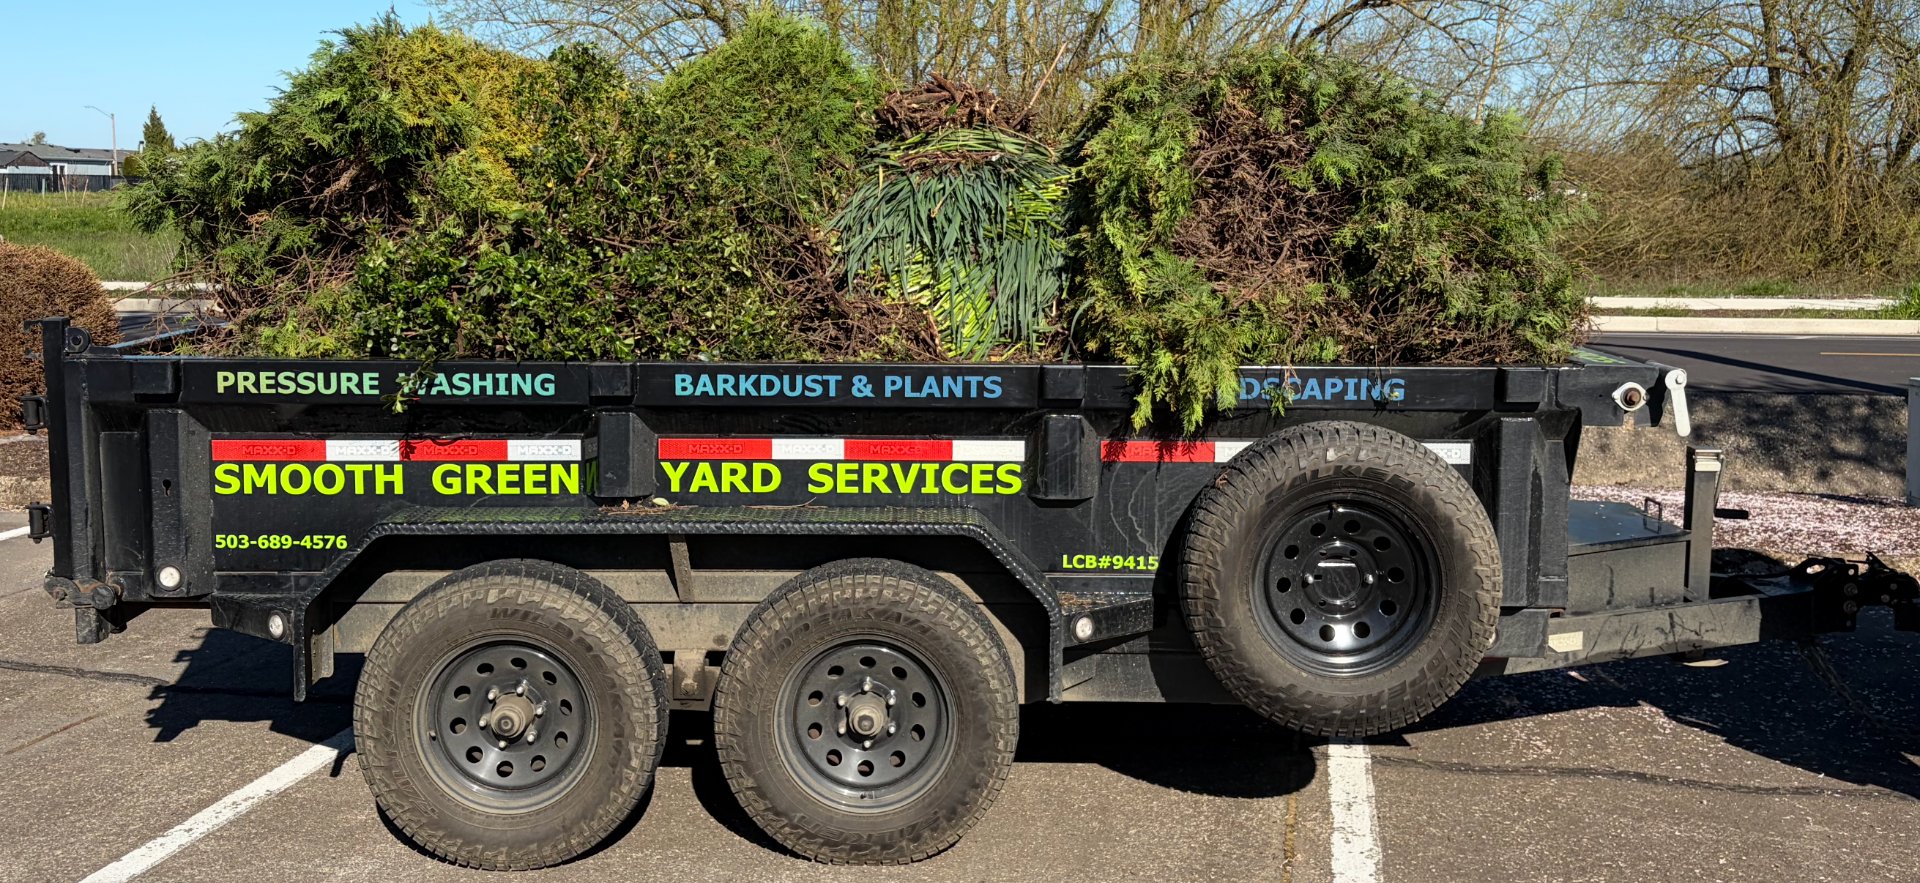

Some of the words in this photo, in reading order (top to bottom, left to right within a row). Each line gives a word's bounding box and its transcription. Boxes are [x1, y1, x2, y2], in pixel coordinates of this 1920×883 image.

[216, 372, 380, 395] PRESSURE
[674, 374, 842, 398] BARKDUST
[851, 374, 876, 398] &
[884, 375, 1003, 399] PLANTS
[1240, 378, 1405, 401] DSCAPING
[214, 463, 404, 496] SMOOTH
[431, 463, 580, 495] GREEN
[660, 461, 783, 493] YARD
[807, 462, 1023, 495] SERVICES
[215, 534, 348, 551] 503-689-4576
[1062, 554, 1159, 570] LCB#9415
